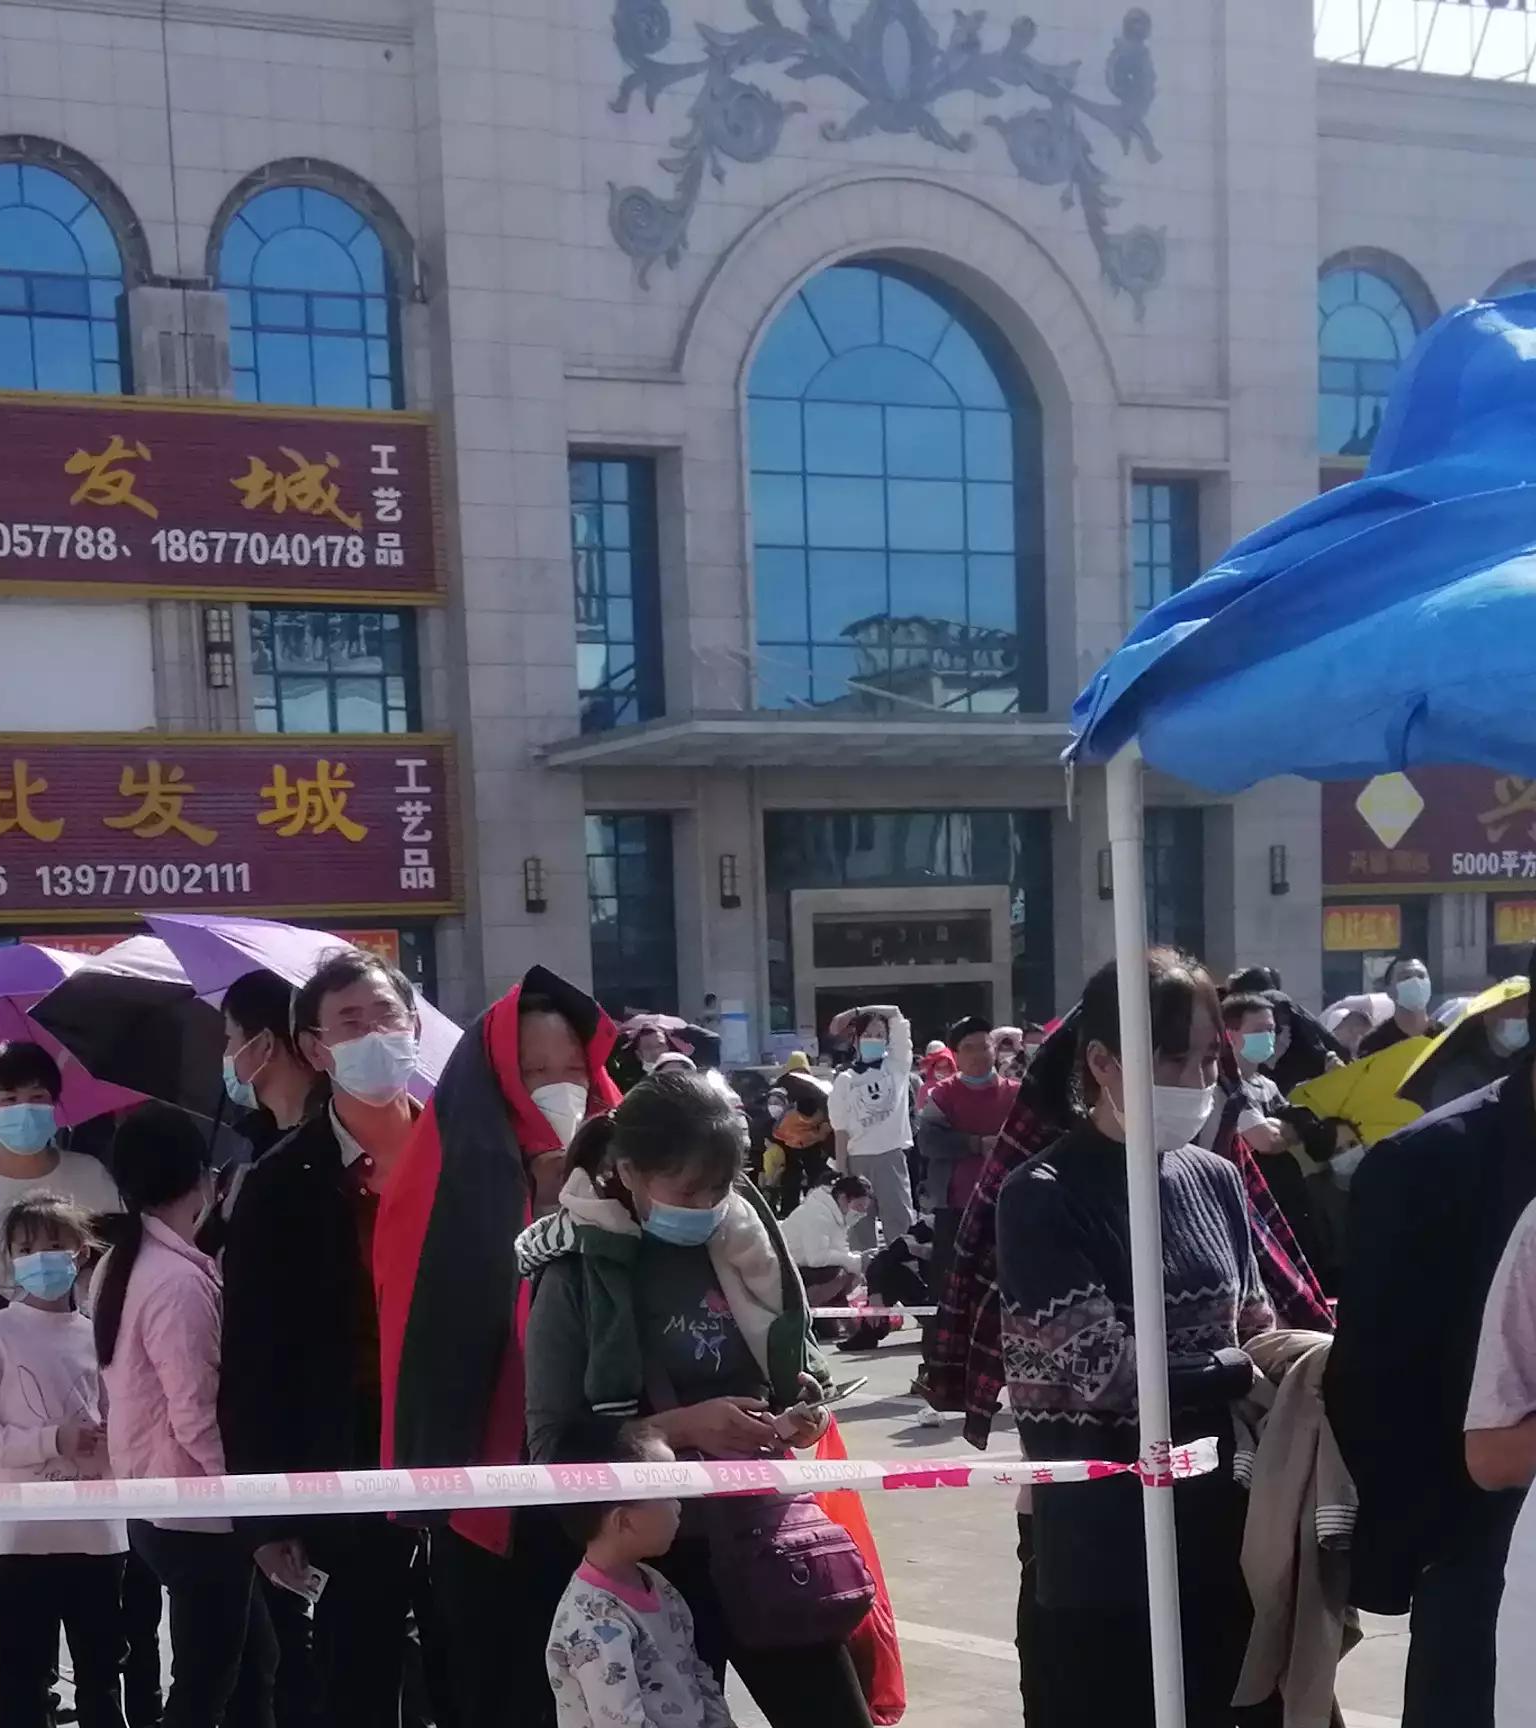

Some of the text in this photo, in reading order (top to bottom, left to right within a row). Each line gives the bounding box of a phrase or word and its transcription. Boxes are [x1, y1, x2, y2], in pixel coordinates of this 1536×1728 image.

[370, 444, 404, 566] 工艺品
[151, 529, 365, 568] 18677040178
[394, 759, 435, 890] 工艺品
[36, 861, 252, 897] 13977002111
